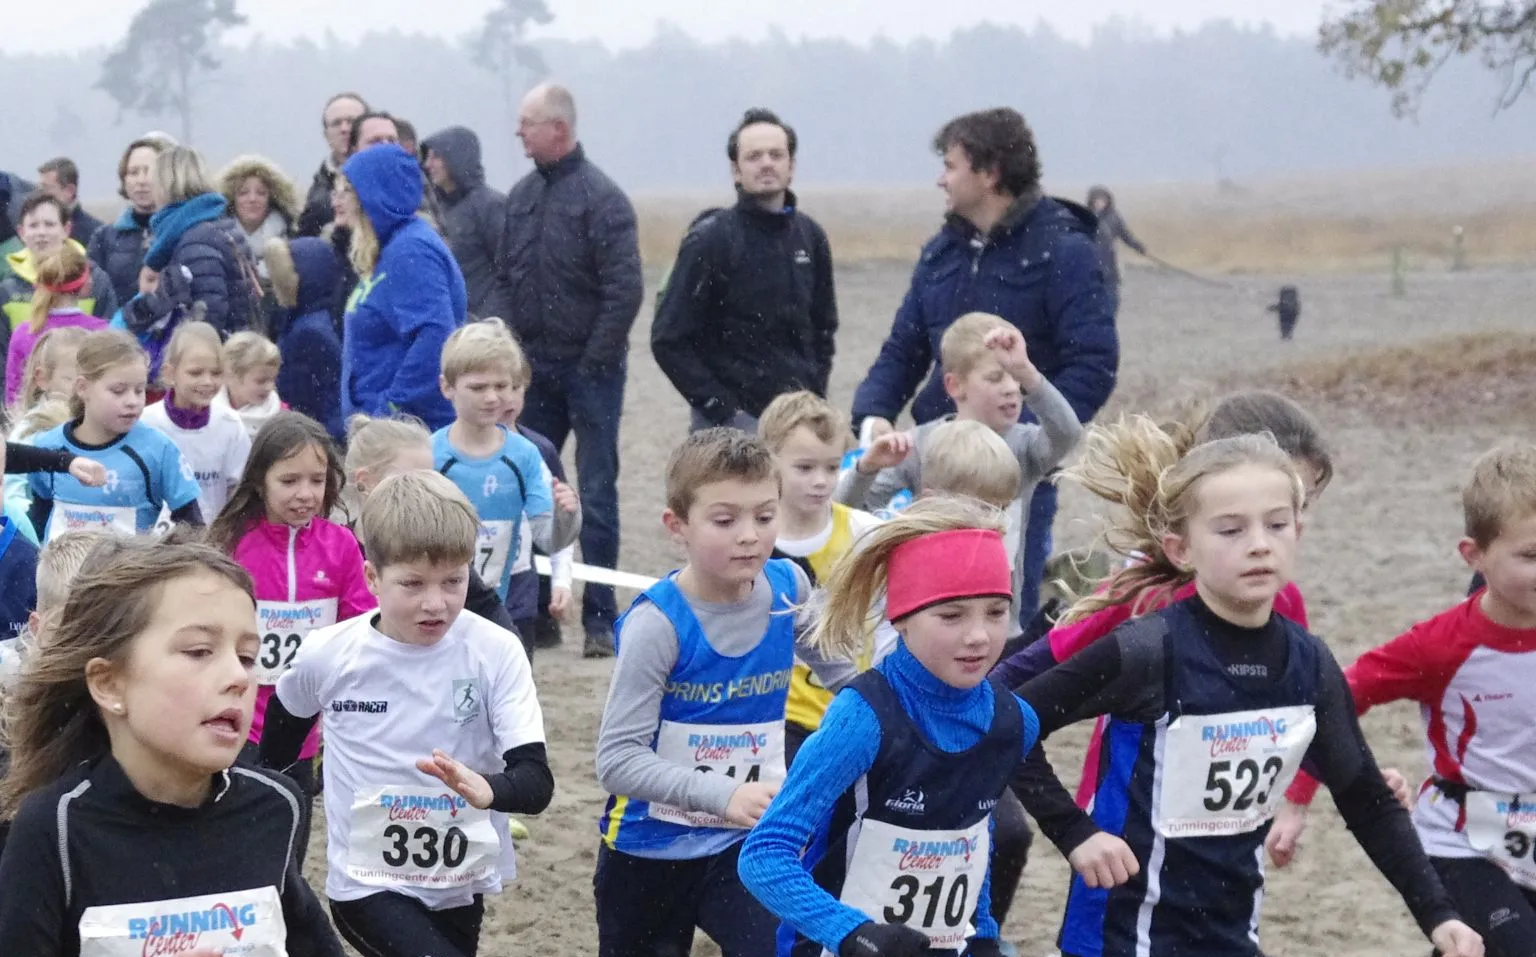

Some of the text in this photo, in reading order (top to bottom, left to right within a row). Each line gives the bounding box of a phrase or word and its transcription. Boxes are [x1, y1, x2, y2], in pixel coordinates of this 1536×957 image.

[260, 606, 321, 619] RUNNING
[665, 681, 723, 703] PRINS
[358, 700, 388, 713] RACER
[688, 734, 767, 748] RUNNING
[1202, 719, 1287, 742] RUNNING
[380, 795, 467, 811] RUNNING
[1168, 819, 1257, 833] runningcenter
[383, 824, 469, 869] 330
[893, 835, 978, 857] RUNNING
[899, 844, 943, 871] Center
[883, 874, 968, 928] 310
[128, 904, 256, 939] RUNNING
